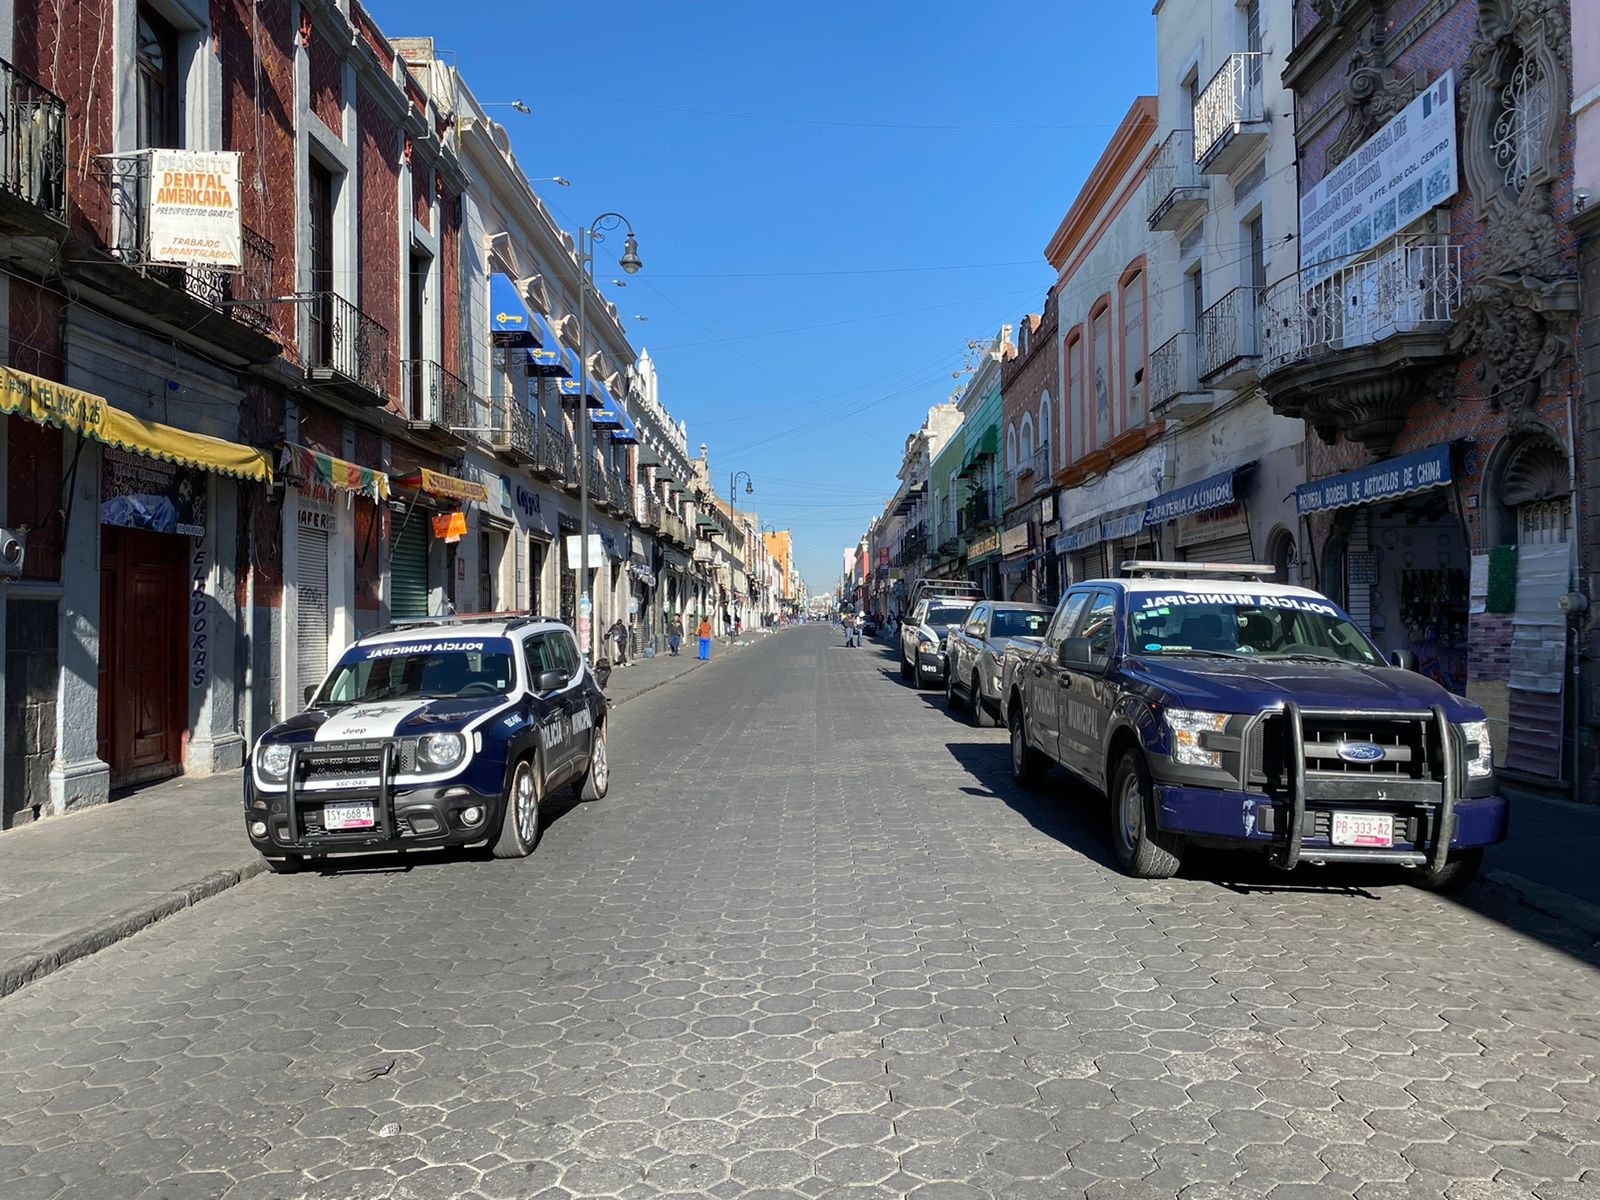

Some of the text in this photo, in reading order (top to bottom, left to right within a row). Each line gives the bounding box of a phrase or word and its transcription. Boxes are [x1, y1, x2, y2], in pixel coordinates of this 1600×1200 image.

[1358, 132, 1393, 171] BODEGA
[1394, 114, 1409, 143] DE
[1369, 195, 1375, 205] 8
[1374, 184, 1388, 201] PTE.
[1404, 161, 1421, 179] COL.
[1420, 138, 1450, 167] CENTRO
[163, 172, 226, 190] DENTAL
[1342, 178, 1355, 208] DE
[1355, 160, 1382, 196] CHINA
[156, 188, 233, 207] AMERICANA
[155, 207, 234, 219] PRESUPUESTOS GRATIS
[172, 237, 221, 248] TRABAJOS
[160, 246, 234, 259] GARANTIZADOS
[1300, 460, 1441, 507] PRIMERA BODEGA DE ARTICULOS DE CHINA
[1146, 482, 1231, 521] ZAPATERIA LA UNION
[1068, 698, 1099, 739] MUNICIPAL
[342, 727, 367, 735] Jeep
[1350, 747, 1377, 759] Ford
[326, 807, 372, 821] TSY-668-A
[1335, 820, 1391, 836] PB-333-A2
